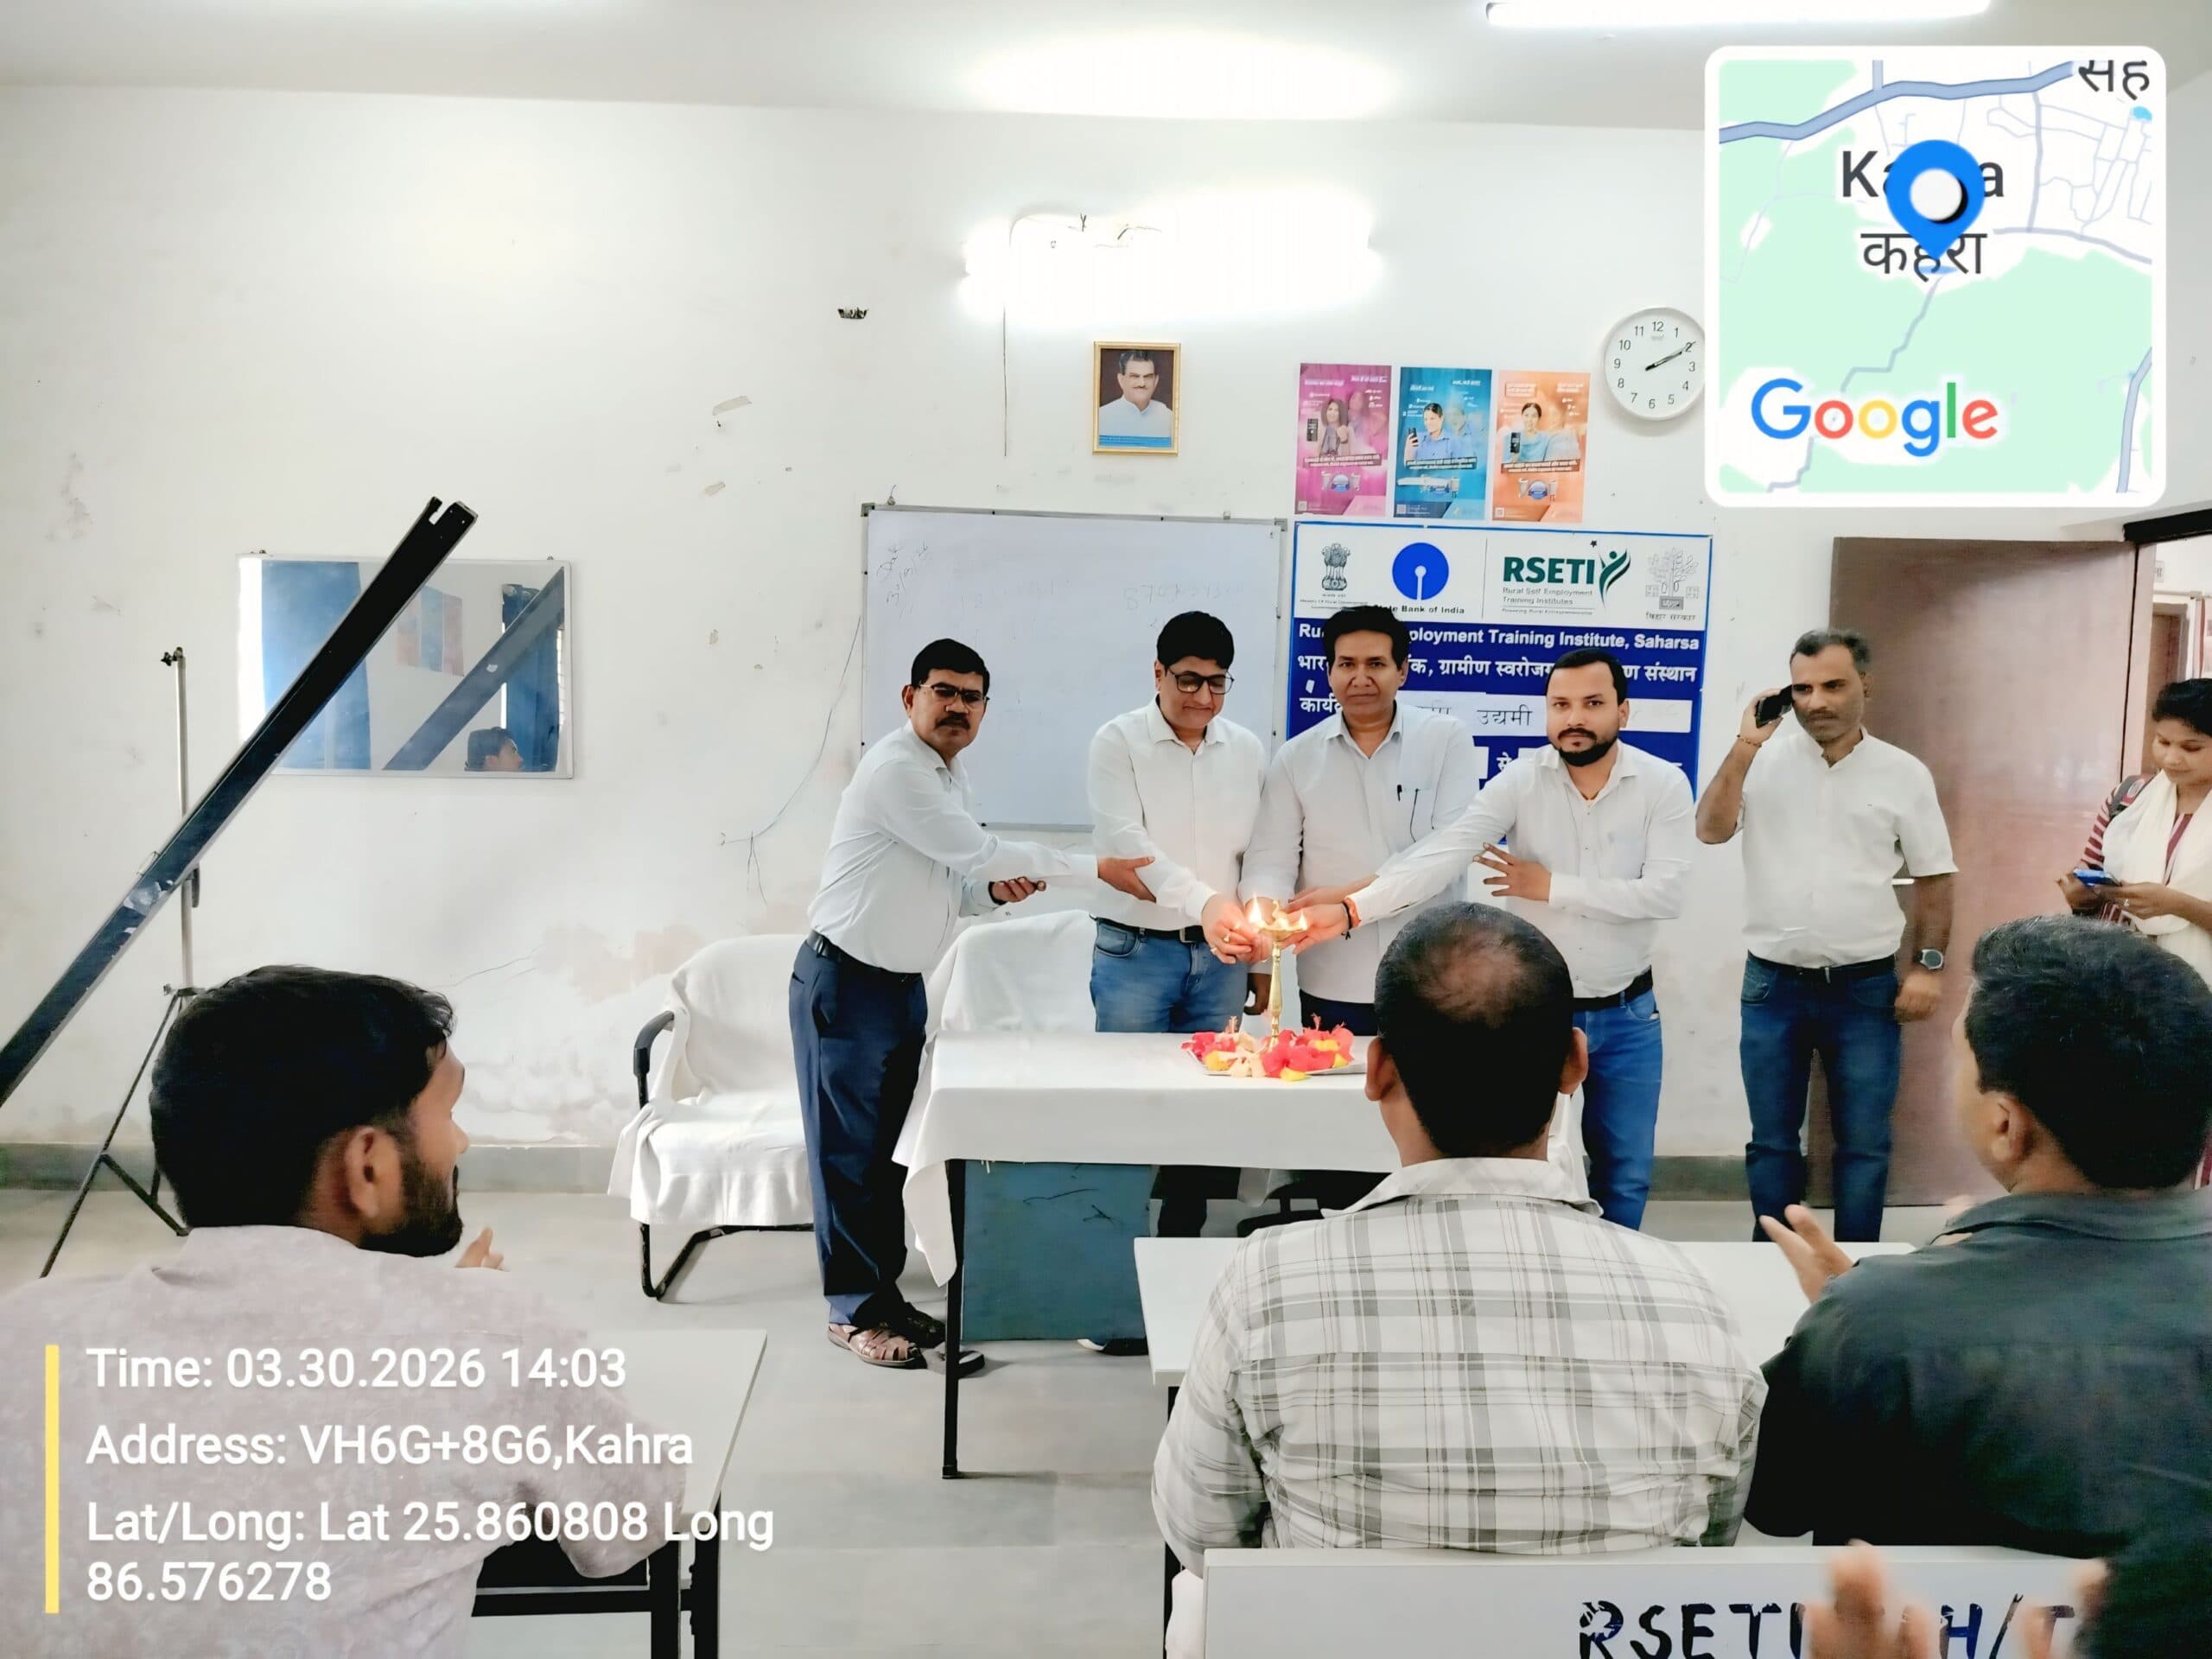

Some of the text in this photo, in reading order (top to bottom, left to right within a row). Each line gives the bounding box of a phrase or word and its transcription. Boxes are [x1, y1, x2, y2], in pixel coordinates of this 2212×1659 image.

[1635, 326, 1644, 336] 11
[1652, 321, 1664, 332] 12
[1619, 340, 1631, 350] 10
[1614, 359, 1621, 369] 9
[1688, 361, 1695, 372] 3
[1618, 378, 1624, 388] 8
[1682, 380, 1688, 391] 4
[1631, 392, 1637, 404] 7
[1649, 398, 1656, 409] 6
[1668, 394, 1675, 404] 5
[1503, 556, 1596, 585] RSETI
[1402, 605, 1425, 613] Bank
[1488, 628, 1554, 648] Training
[1559, 632, 1630, 649] Institute,
[1634, 633, 1700, 650] Saharsa
[1438, 655, 1491, 675] ग्रामीण
[1644, 661, 1697, 683] संस्थान
[1477, 704, 1533, 726] उद्यमी
